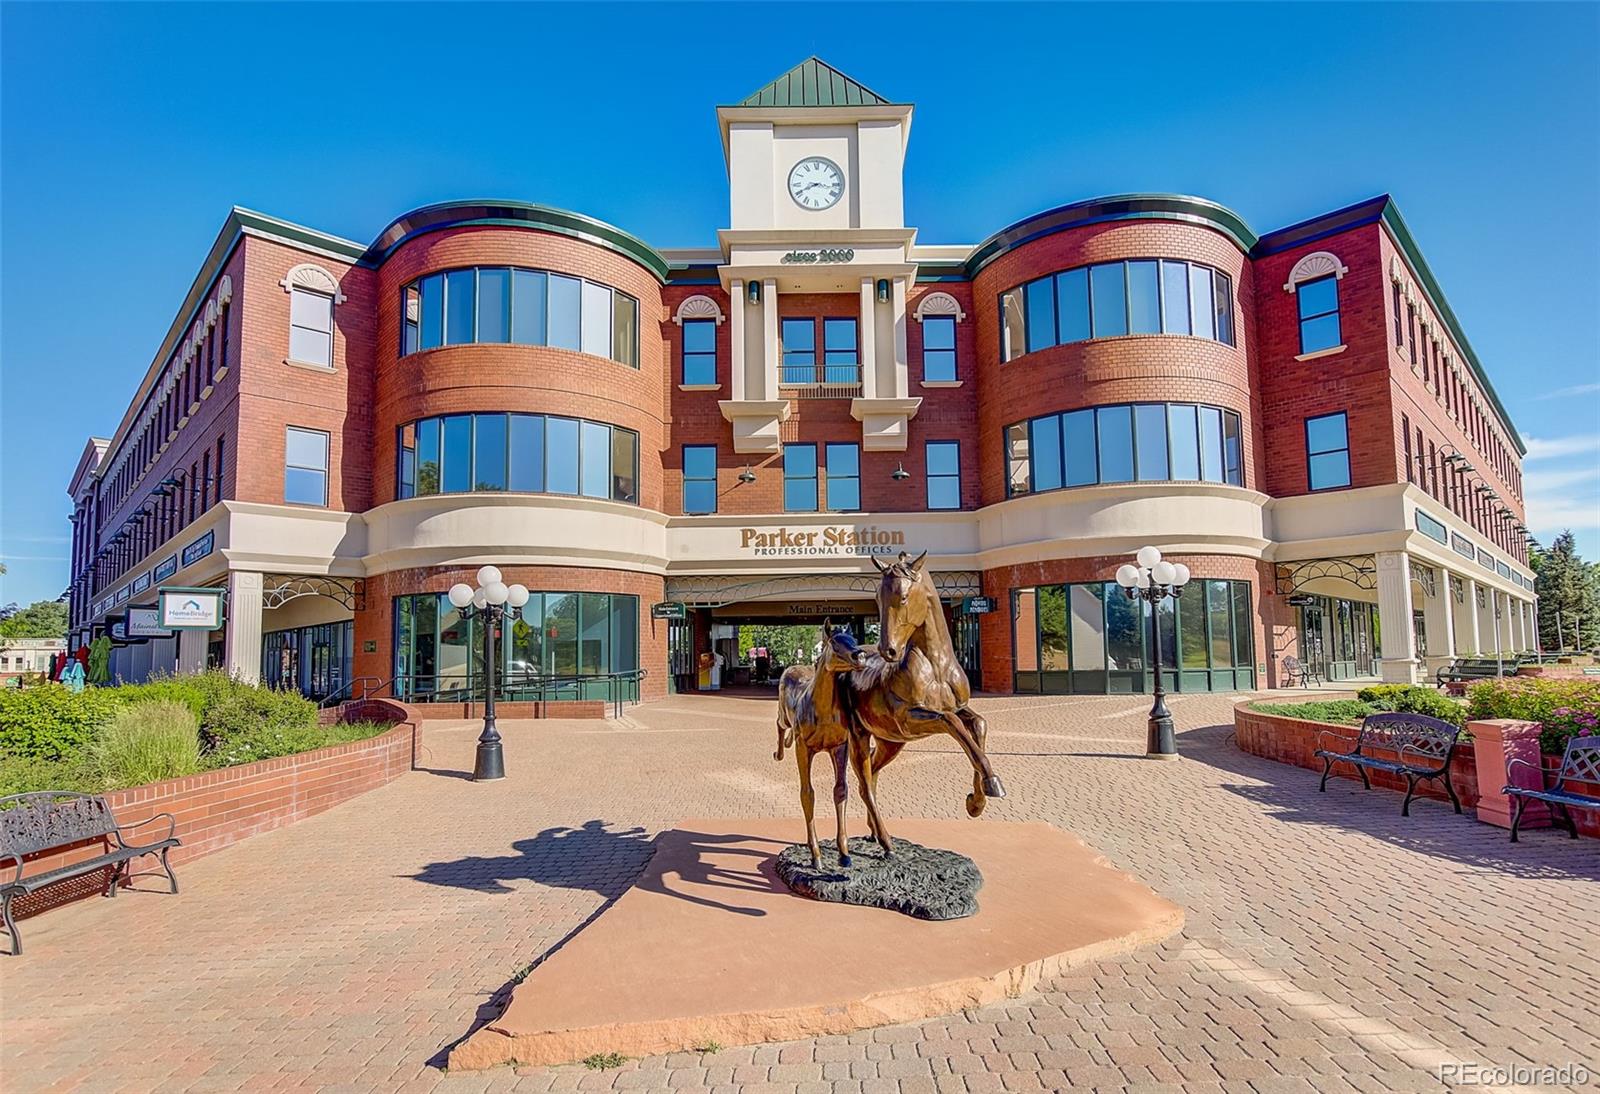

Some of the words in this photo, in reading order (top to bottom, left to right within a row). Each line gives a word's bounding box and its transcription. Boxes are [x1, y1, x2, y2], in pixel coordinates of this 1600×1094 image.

[819, 249, 855, 263] 2000
[740, 527, 818, 548] Parker
[823, 526, 905, 547] Station
[754, 547, 839, 556] PROFESSIONAL
[845, 546, 892, 555] OFFICES
[789, 604, 815, 614] Main
[816, 604, 855, 614] Entrance
